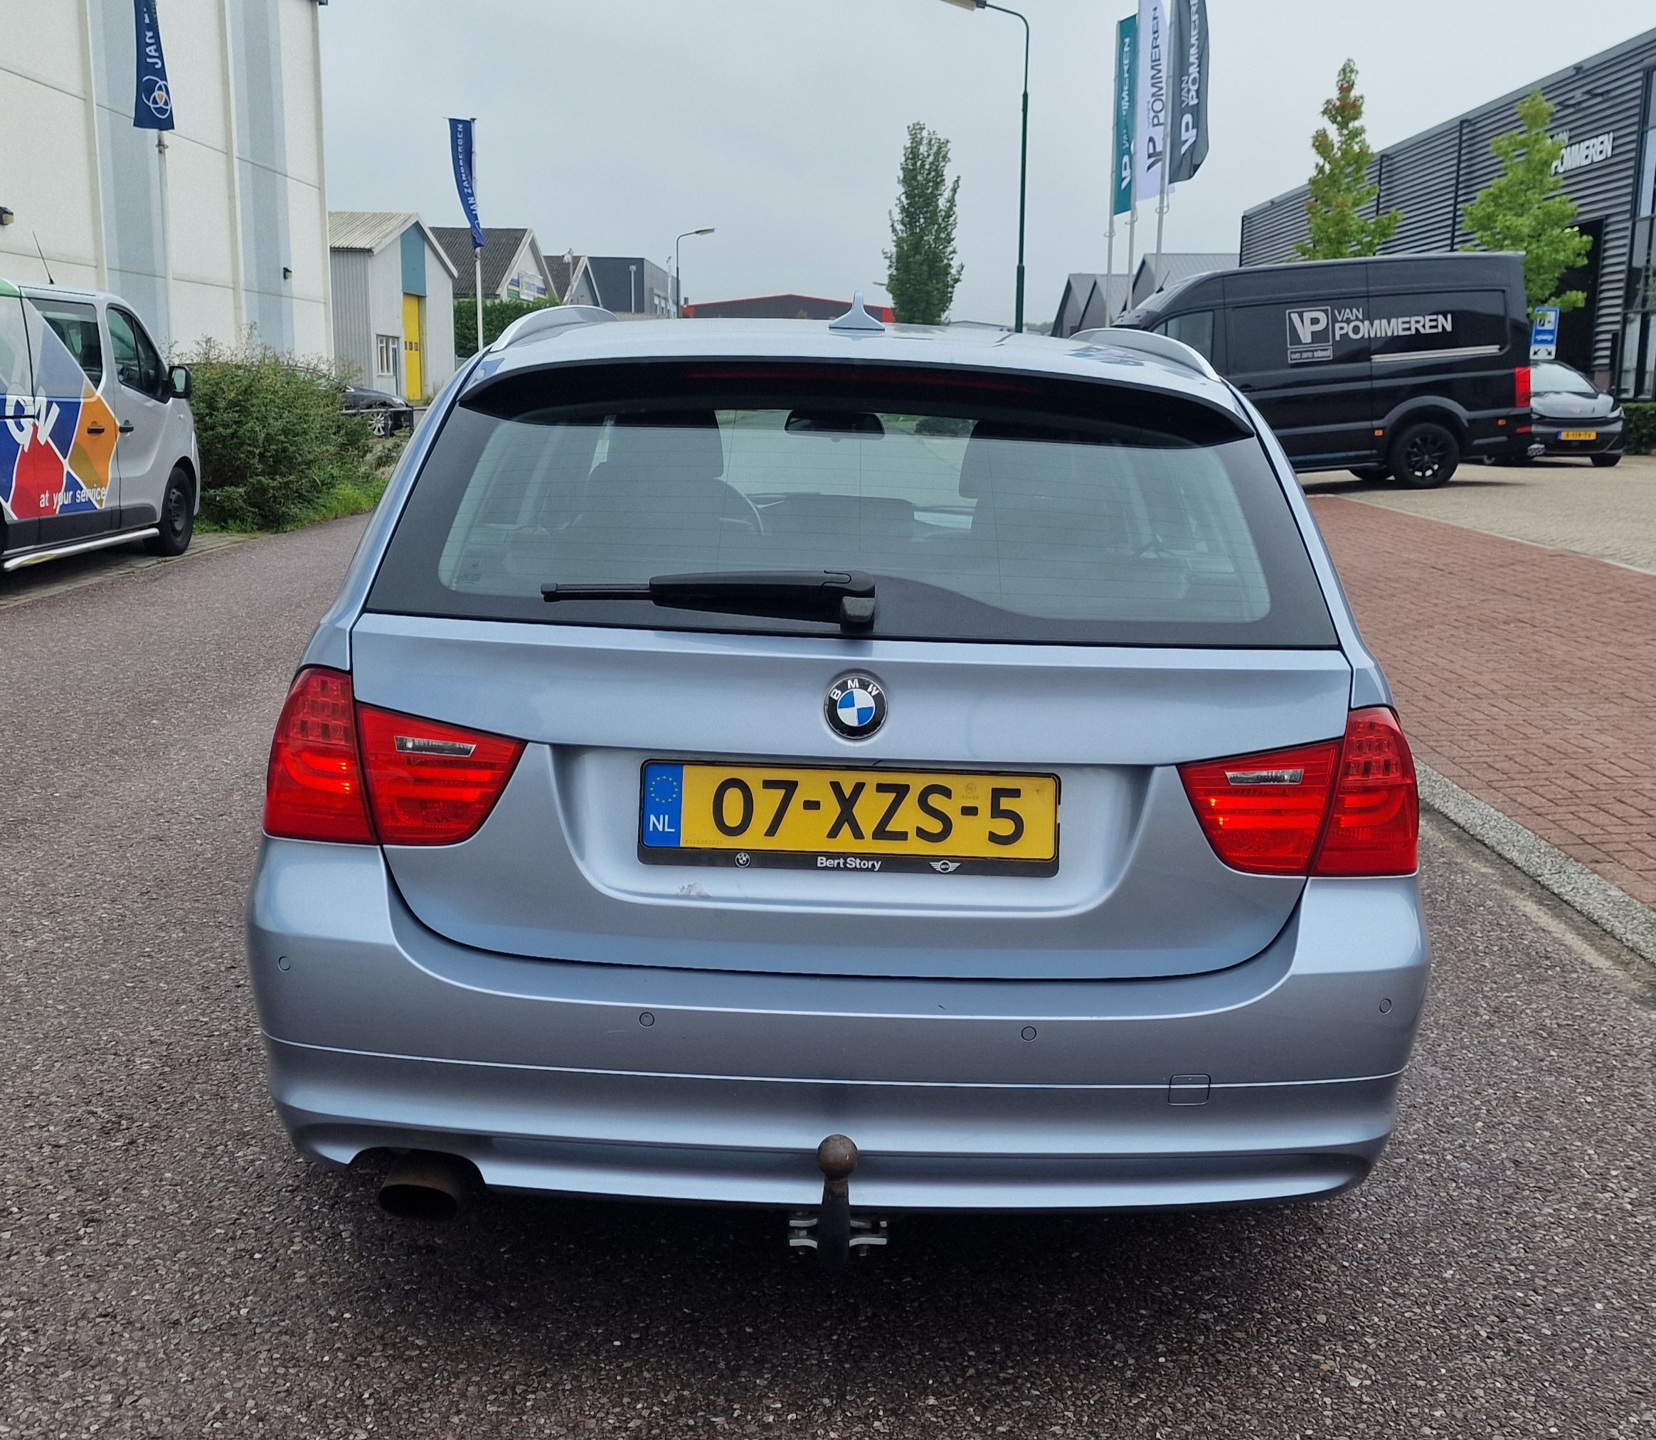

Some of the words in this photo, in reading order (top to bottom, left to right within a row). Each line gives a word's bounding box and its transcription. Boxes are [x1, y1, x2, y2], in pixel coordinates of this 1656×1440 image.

[1151, 6, 1165, 128] POMMEREN
[1181, 76, 1189, 108] VAN
[1334, 307, 1363, 322] VAN
[1334, 313, 1453, 342] POMMEREN
[40, 490, 50, 508] at
[52, 489, 73, 510] your
[76, 484, 107, 503] service
[829, 678, 880, 701] BMW
[649, 814, 676, 833] NL
[712, 777, 1025, 846] 07-XZS-5
[817, 856, 845, 868] Bert
[846, 857, 882, 872] Story
